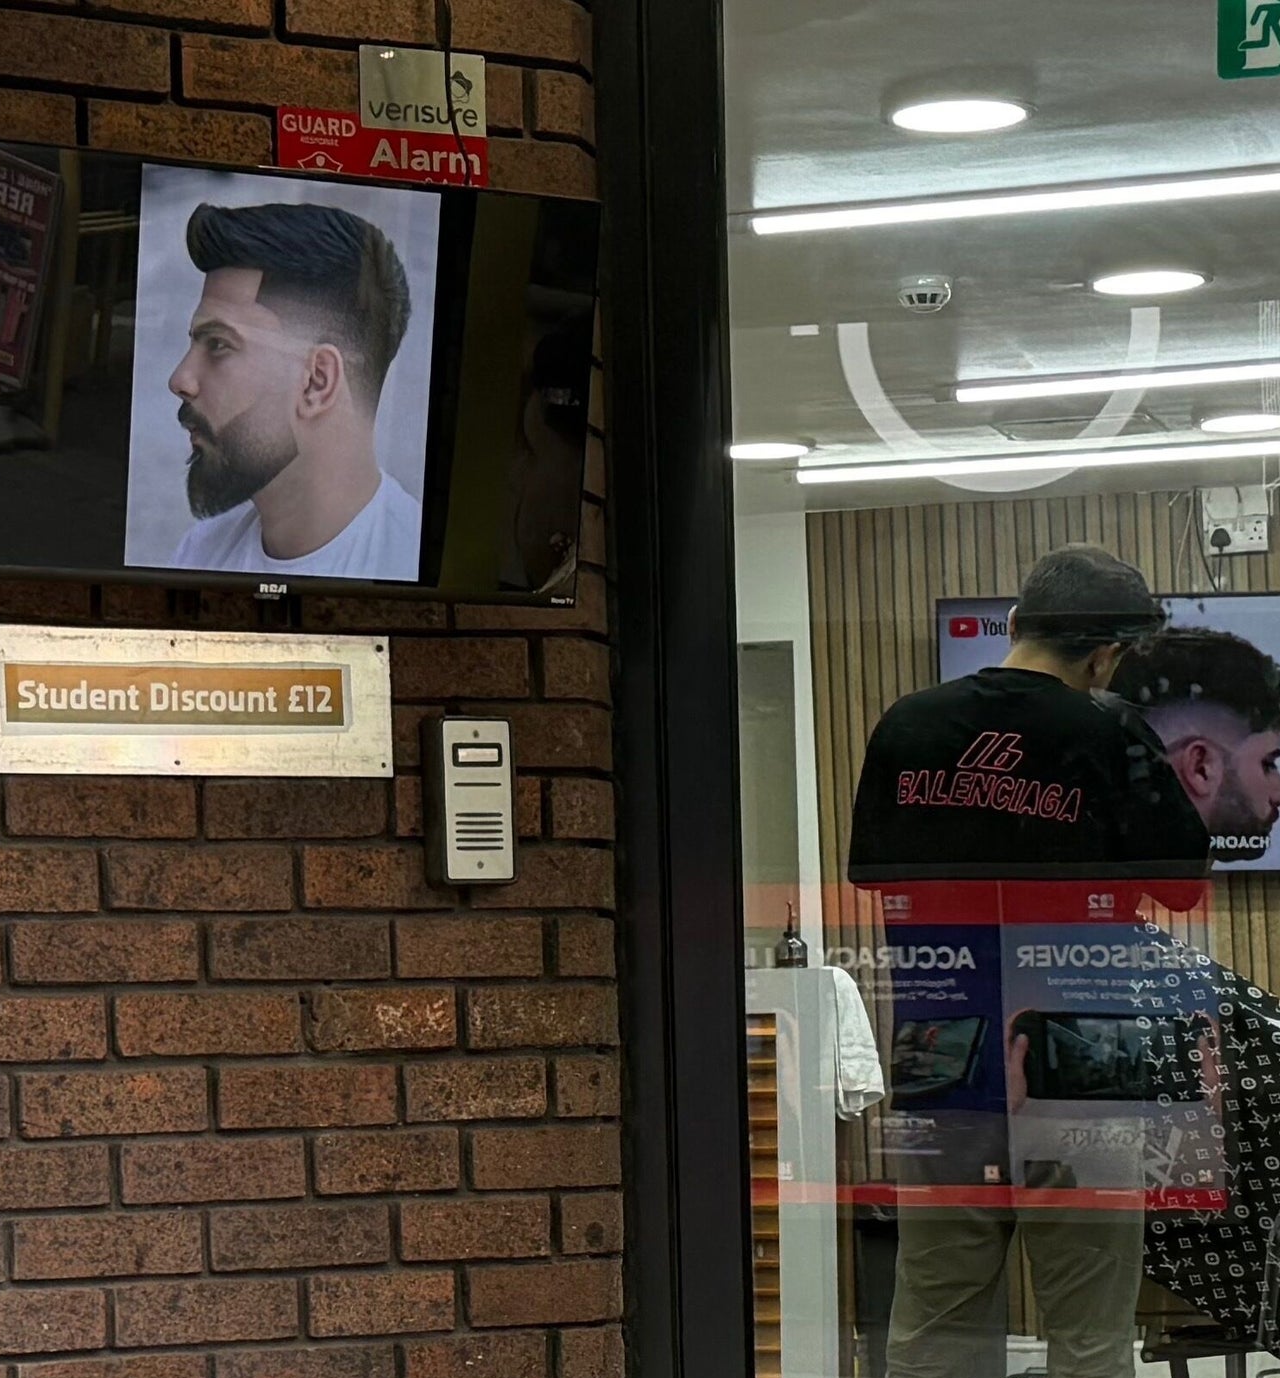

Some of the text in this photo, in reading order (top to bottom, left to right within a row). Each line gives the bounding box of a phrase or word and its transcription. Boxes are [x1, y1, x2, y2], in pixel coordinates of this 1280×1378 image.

[282, 114, 356, 137] GUARD
[370, 101, 478, 127] verisure
[370, 138, 481, 175] Alarm
[260, 584, 288, 594] RCA
[981, 617, 1008, 636] You
[17, 679, 334, 715] Student Discount £12
[897, 770, 1081, 823] BALENCIAGA
